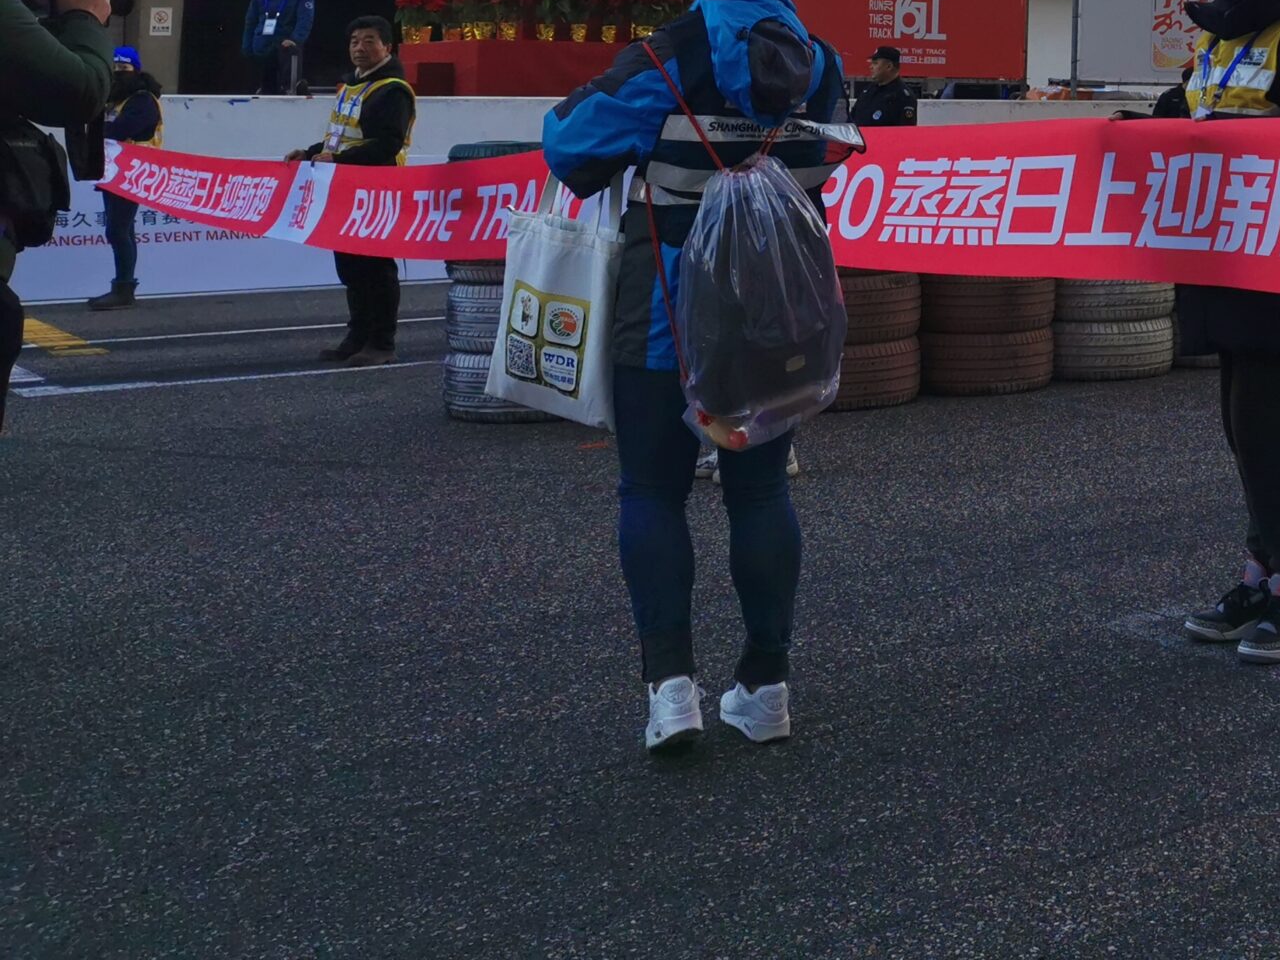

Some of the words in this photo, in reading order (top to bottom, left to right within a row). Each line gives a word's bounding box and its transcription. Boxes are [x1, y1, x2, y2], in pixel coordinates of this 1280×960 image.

[869, 0, 884, 11] RUN
[869, 14, 884, 25] THE
[869, 28, 892, 39] TRACK
[340, 188, 401, 240] RUN
[404, 189, 463, 242] THE
[155, 230, 202, 243] EVENT
[543, 352, 575, 368] WDR
